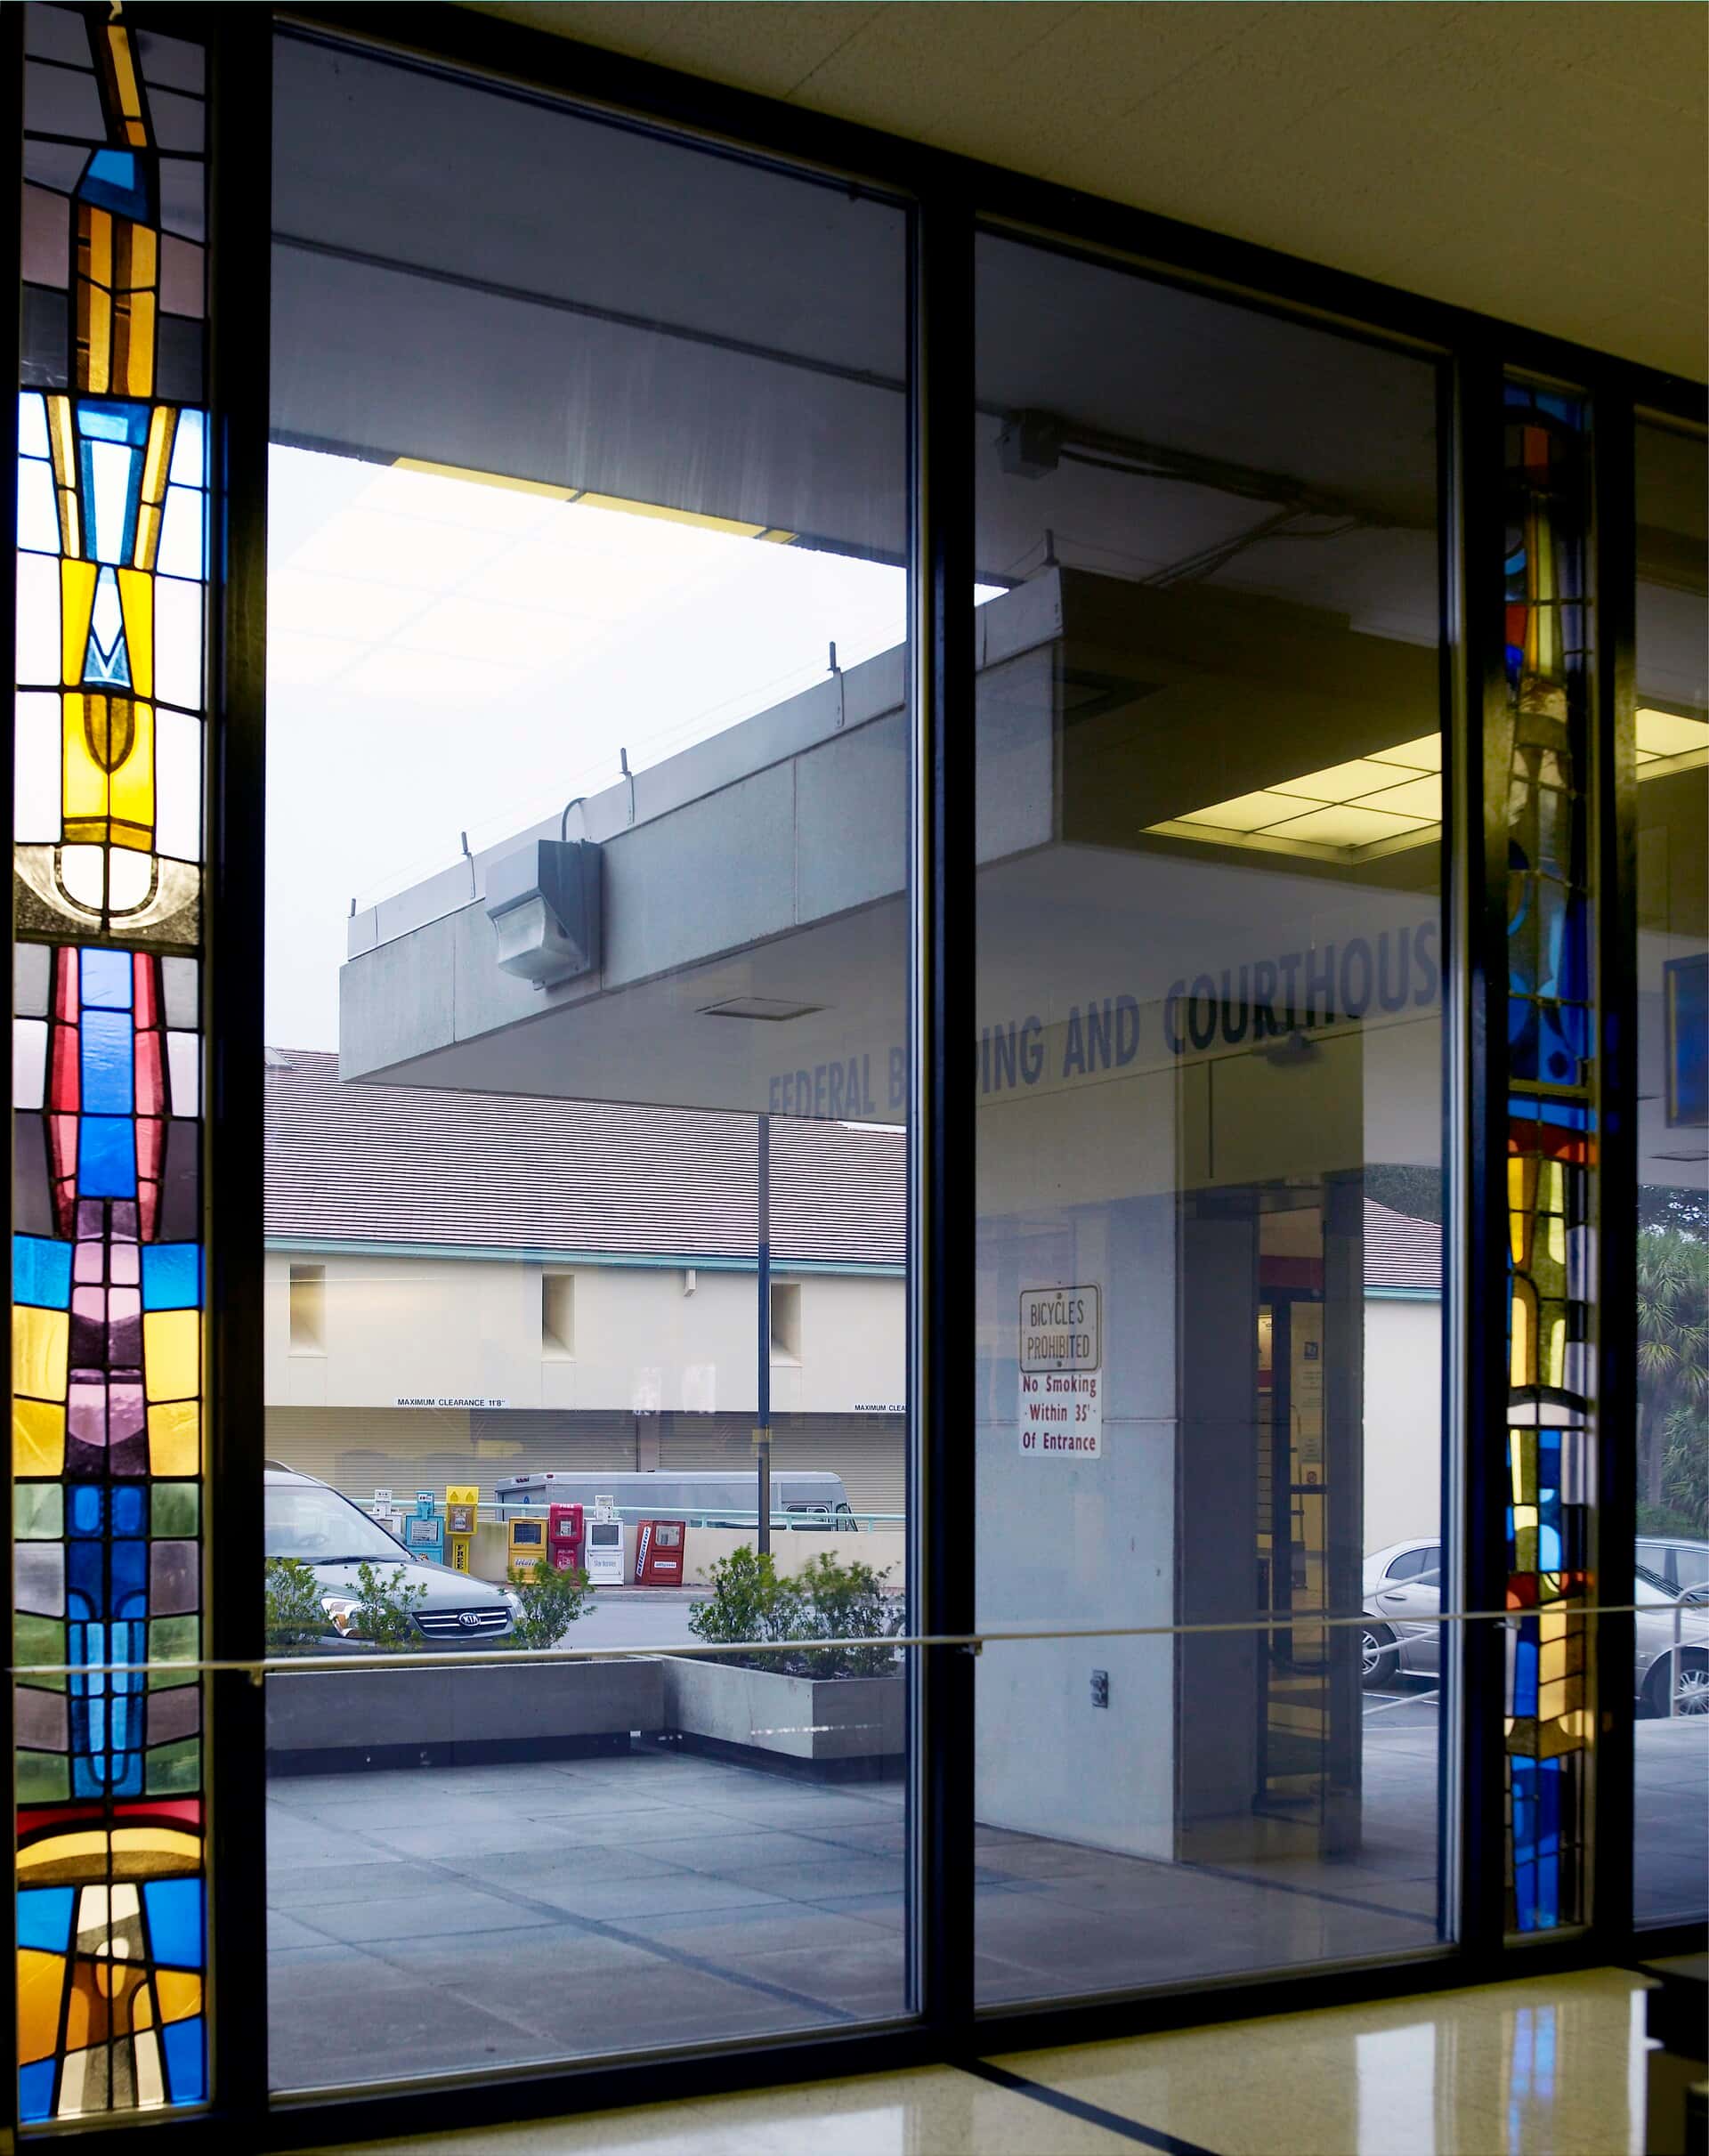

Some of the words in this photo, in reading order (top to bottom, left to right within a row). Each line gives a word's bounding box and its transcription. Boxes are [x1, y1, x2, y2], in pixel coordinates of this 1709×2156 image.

[769, 1053, 876, 1119] FEDERAL
[1063, 994, 1140, 1077] AND
[1163, 920, 1438, 1054] COURTHOUS
[1031, 1300, 1084, 1326] BICYCLES
[1027, 1334, 1089, 1359] PROHIBITED
[1023, 1376, 1039, 1393] No
[1046, 1374, 1097, 1398] Smoking
[438, 1398, 485, 1406] CLEARANCE
[1030, 1404, 1067, 1422] Within
[1023, 1431, 1036, 1449] Of
[1043, 1431, 1096, 1451] Entrance
